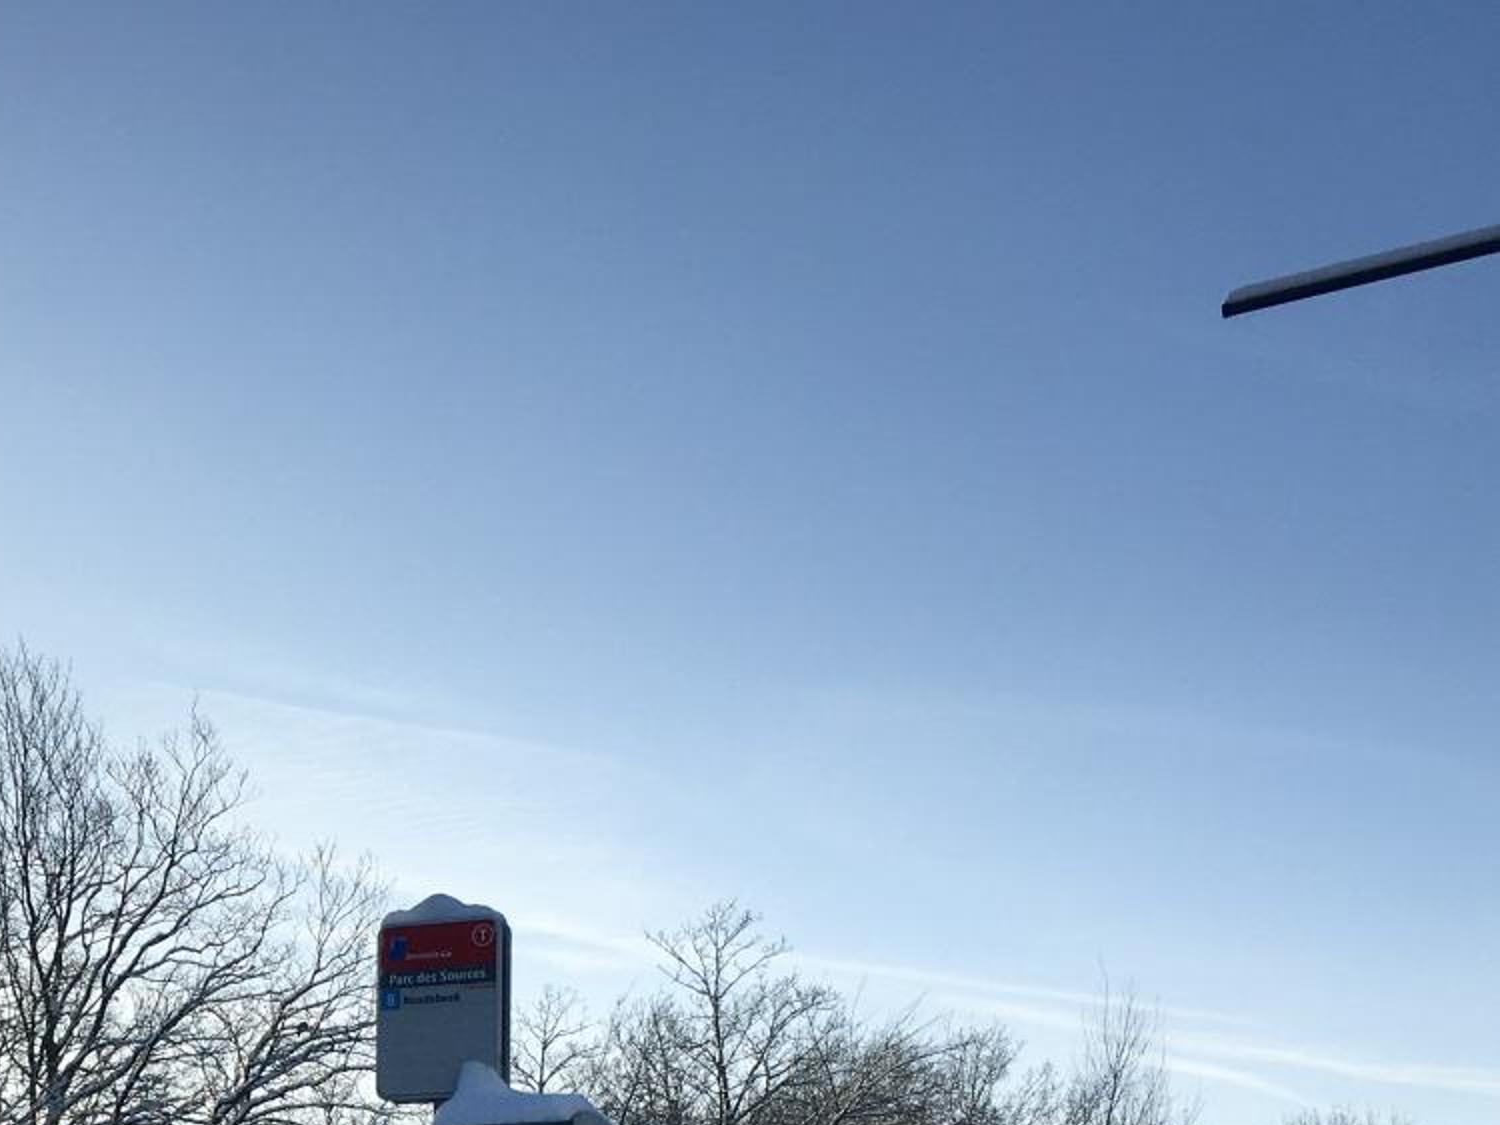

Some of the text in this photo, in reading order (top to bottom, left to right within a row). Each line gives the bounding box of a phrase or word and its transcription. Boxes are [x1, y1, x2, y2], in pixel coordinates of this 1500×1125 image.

[389, 969, 485, 985] Parc des Sources
